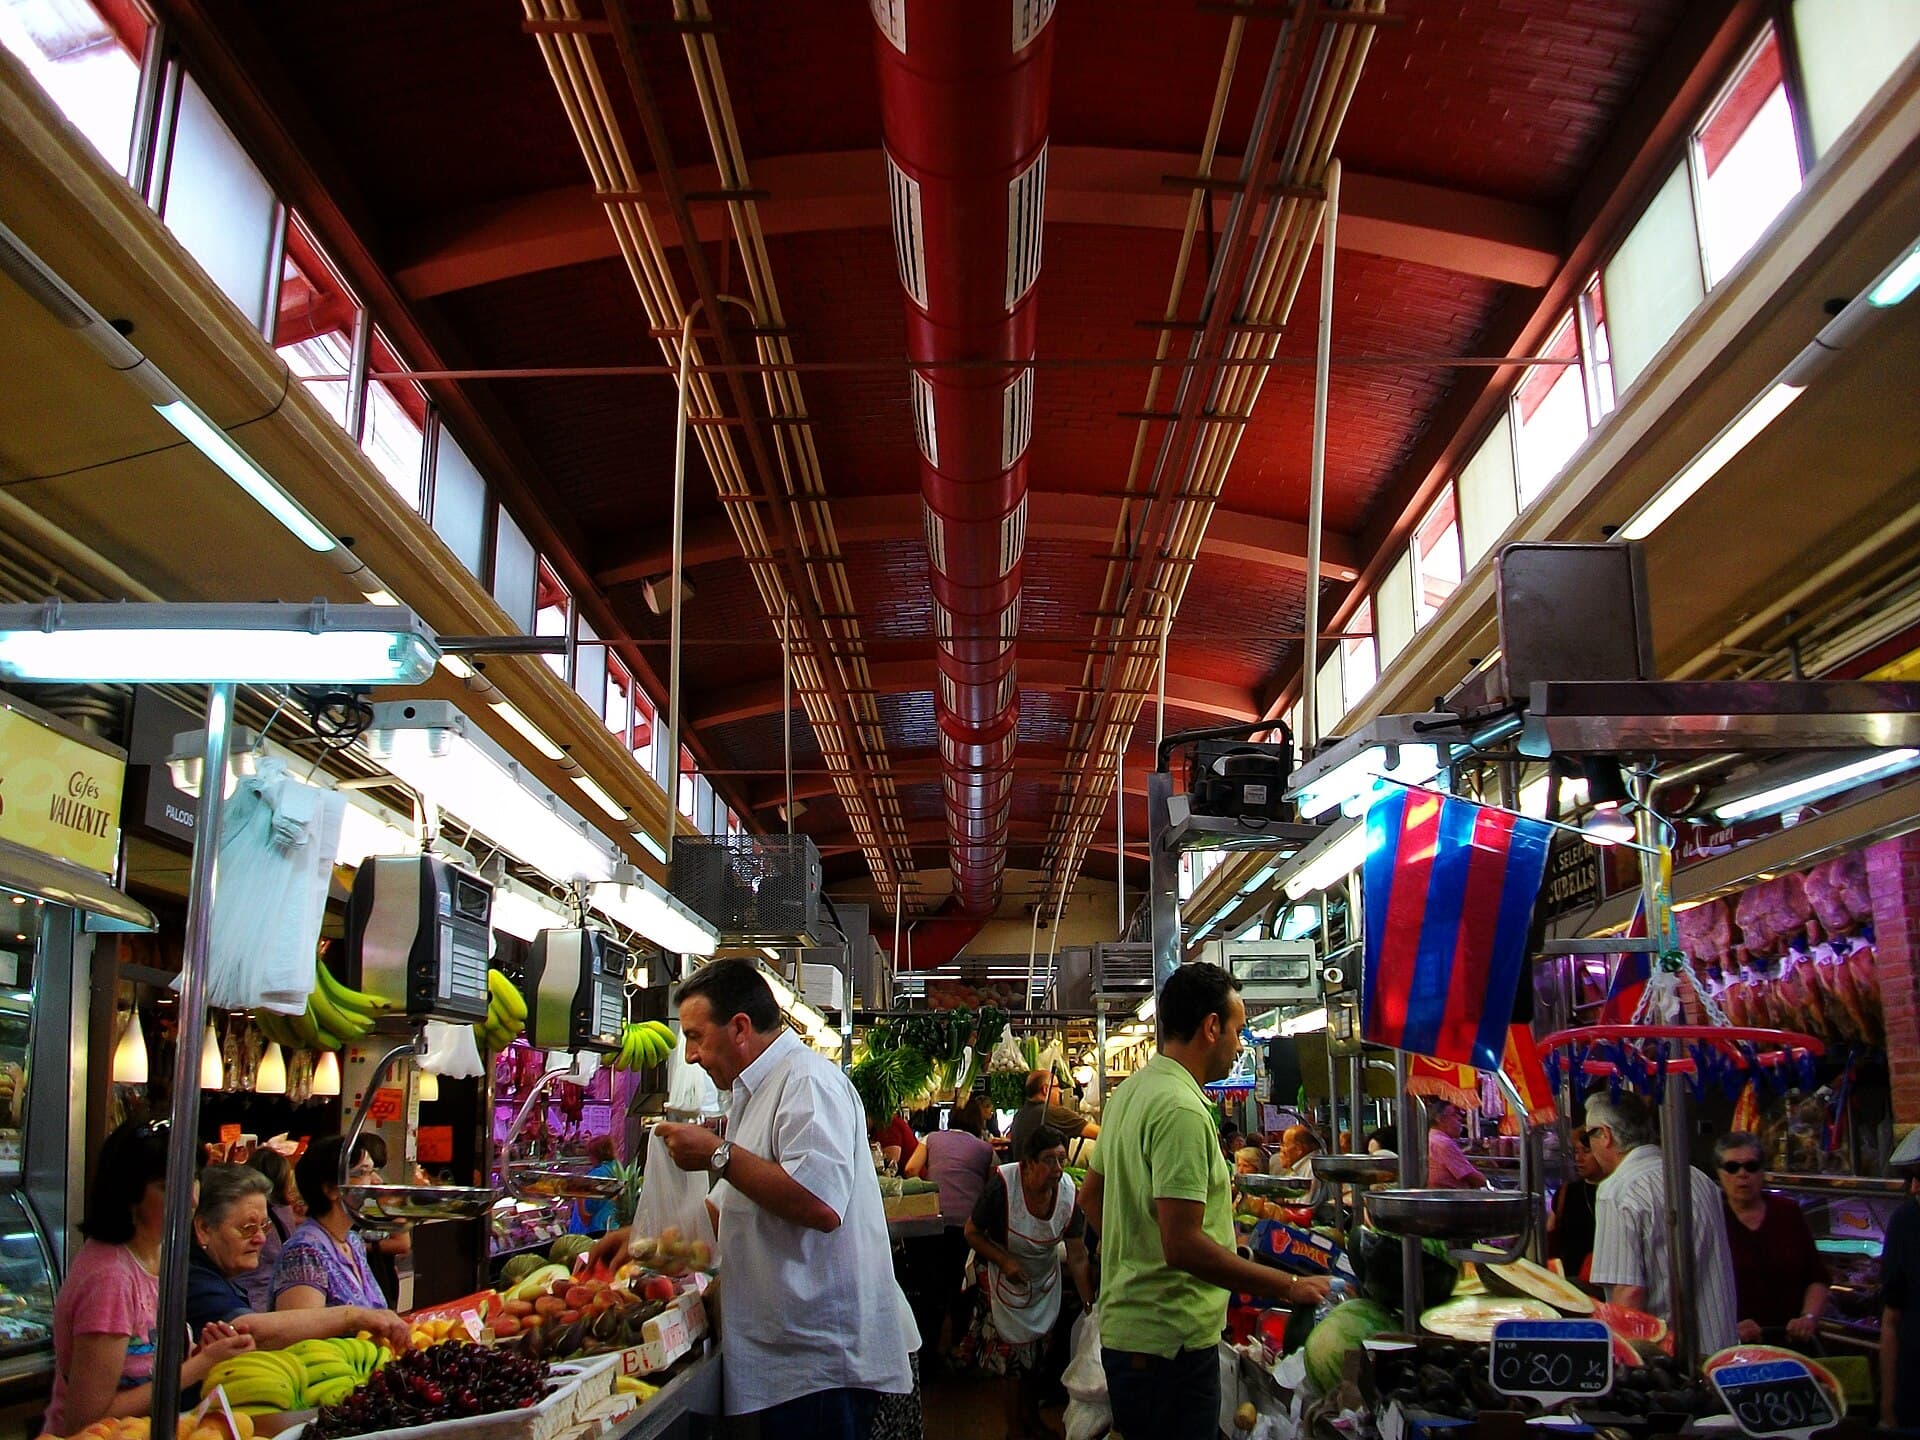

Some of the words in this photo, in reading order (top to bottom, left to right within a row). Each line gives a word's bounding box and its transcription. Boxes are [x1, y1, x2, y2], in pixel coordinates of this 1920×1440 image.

[68, 771, 99, 799] Cafés
[50, 793, 111, 838] VALIENTE
[165, 804, 194, 827] PALCOS
[1580, 1382, 1602, 1390] KILO
